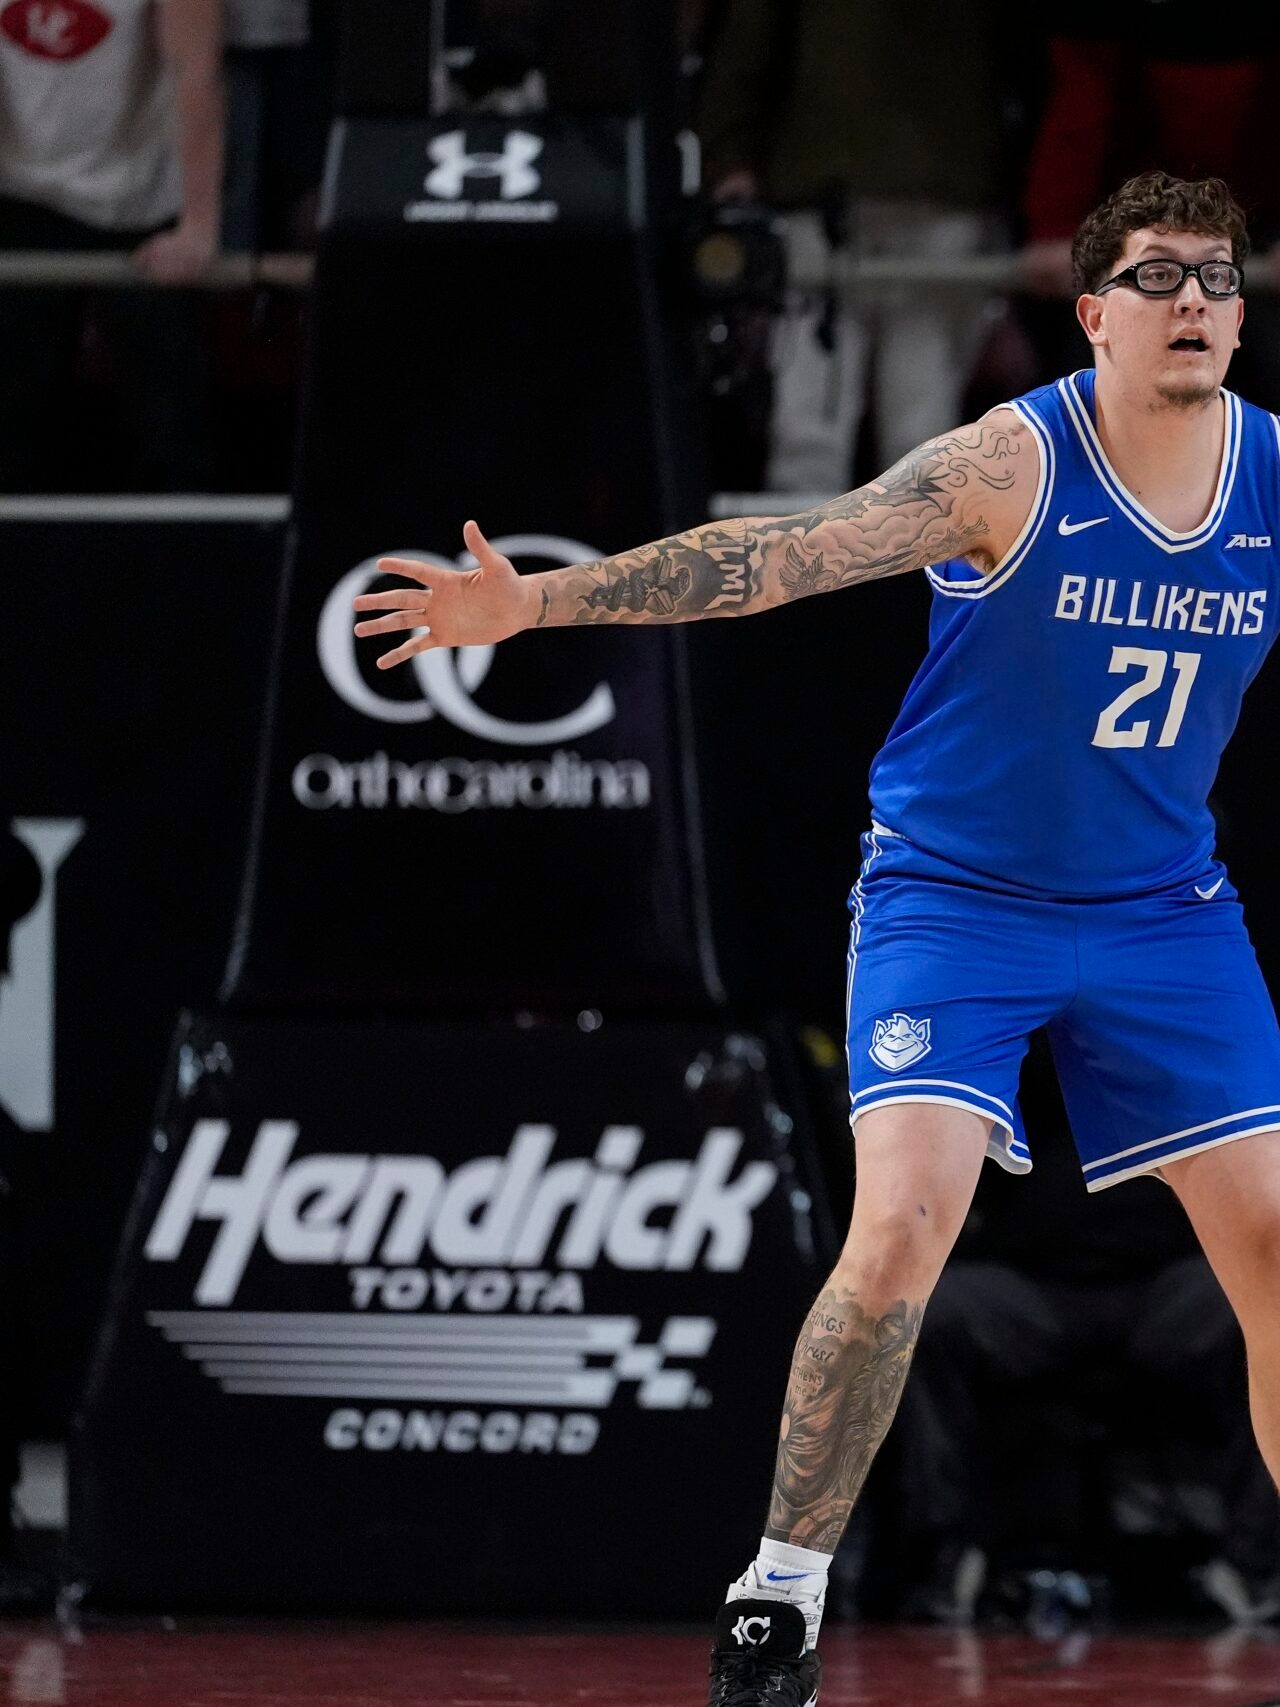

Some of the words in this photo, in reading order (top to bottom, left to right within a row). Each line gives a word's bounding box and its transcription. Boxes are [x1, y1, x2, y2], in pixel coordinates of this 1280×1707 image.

[1225, 534, 1271, 549] A10
[1054, 574, 1265, 635] BILLIKENS
[1091, 646, 1201, 748] 21
[145, 1119, 777, 1307] Hendrick
[350, 1268, 586, 1313] TOYOTA
[324, 1409, 600, 1454] CONCORD
